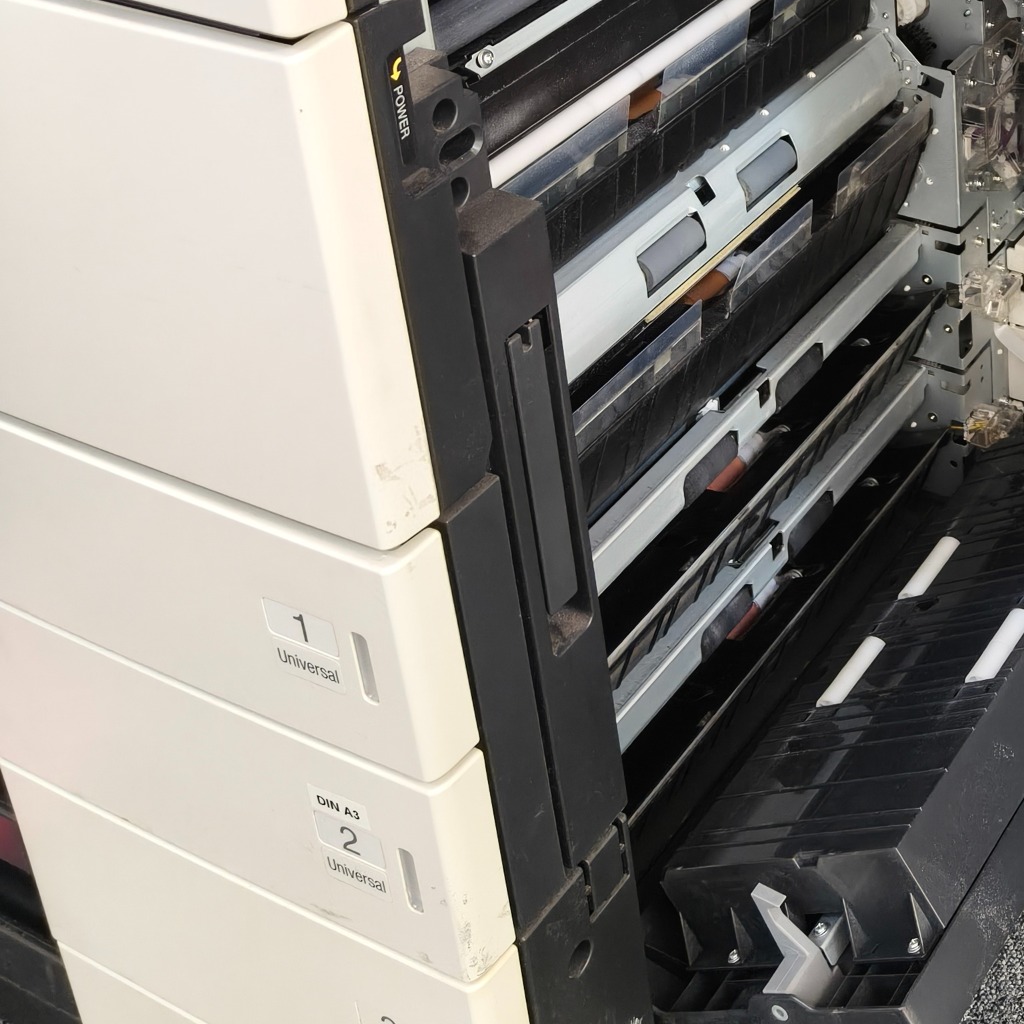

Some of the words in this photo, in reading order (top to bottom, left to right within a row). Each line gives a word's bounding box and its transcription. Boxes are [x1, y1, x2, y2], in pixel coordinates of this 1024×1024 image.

[393, 84, 411, 140] POWER
[292, 613, 309, 643] 1
[277, 647, 340, 684] Universal
[316, 794, 340, 812] DIN
[344, 806, 361, 820] A3
[339, 826, 361, 856] 2
[327, 856, 387, 893] Universal
